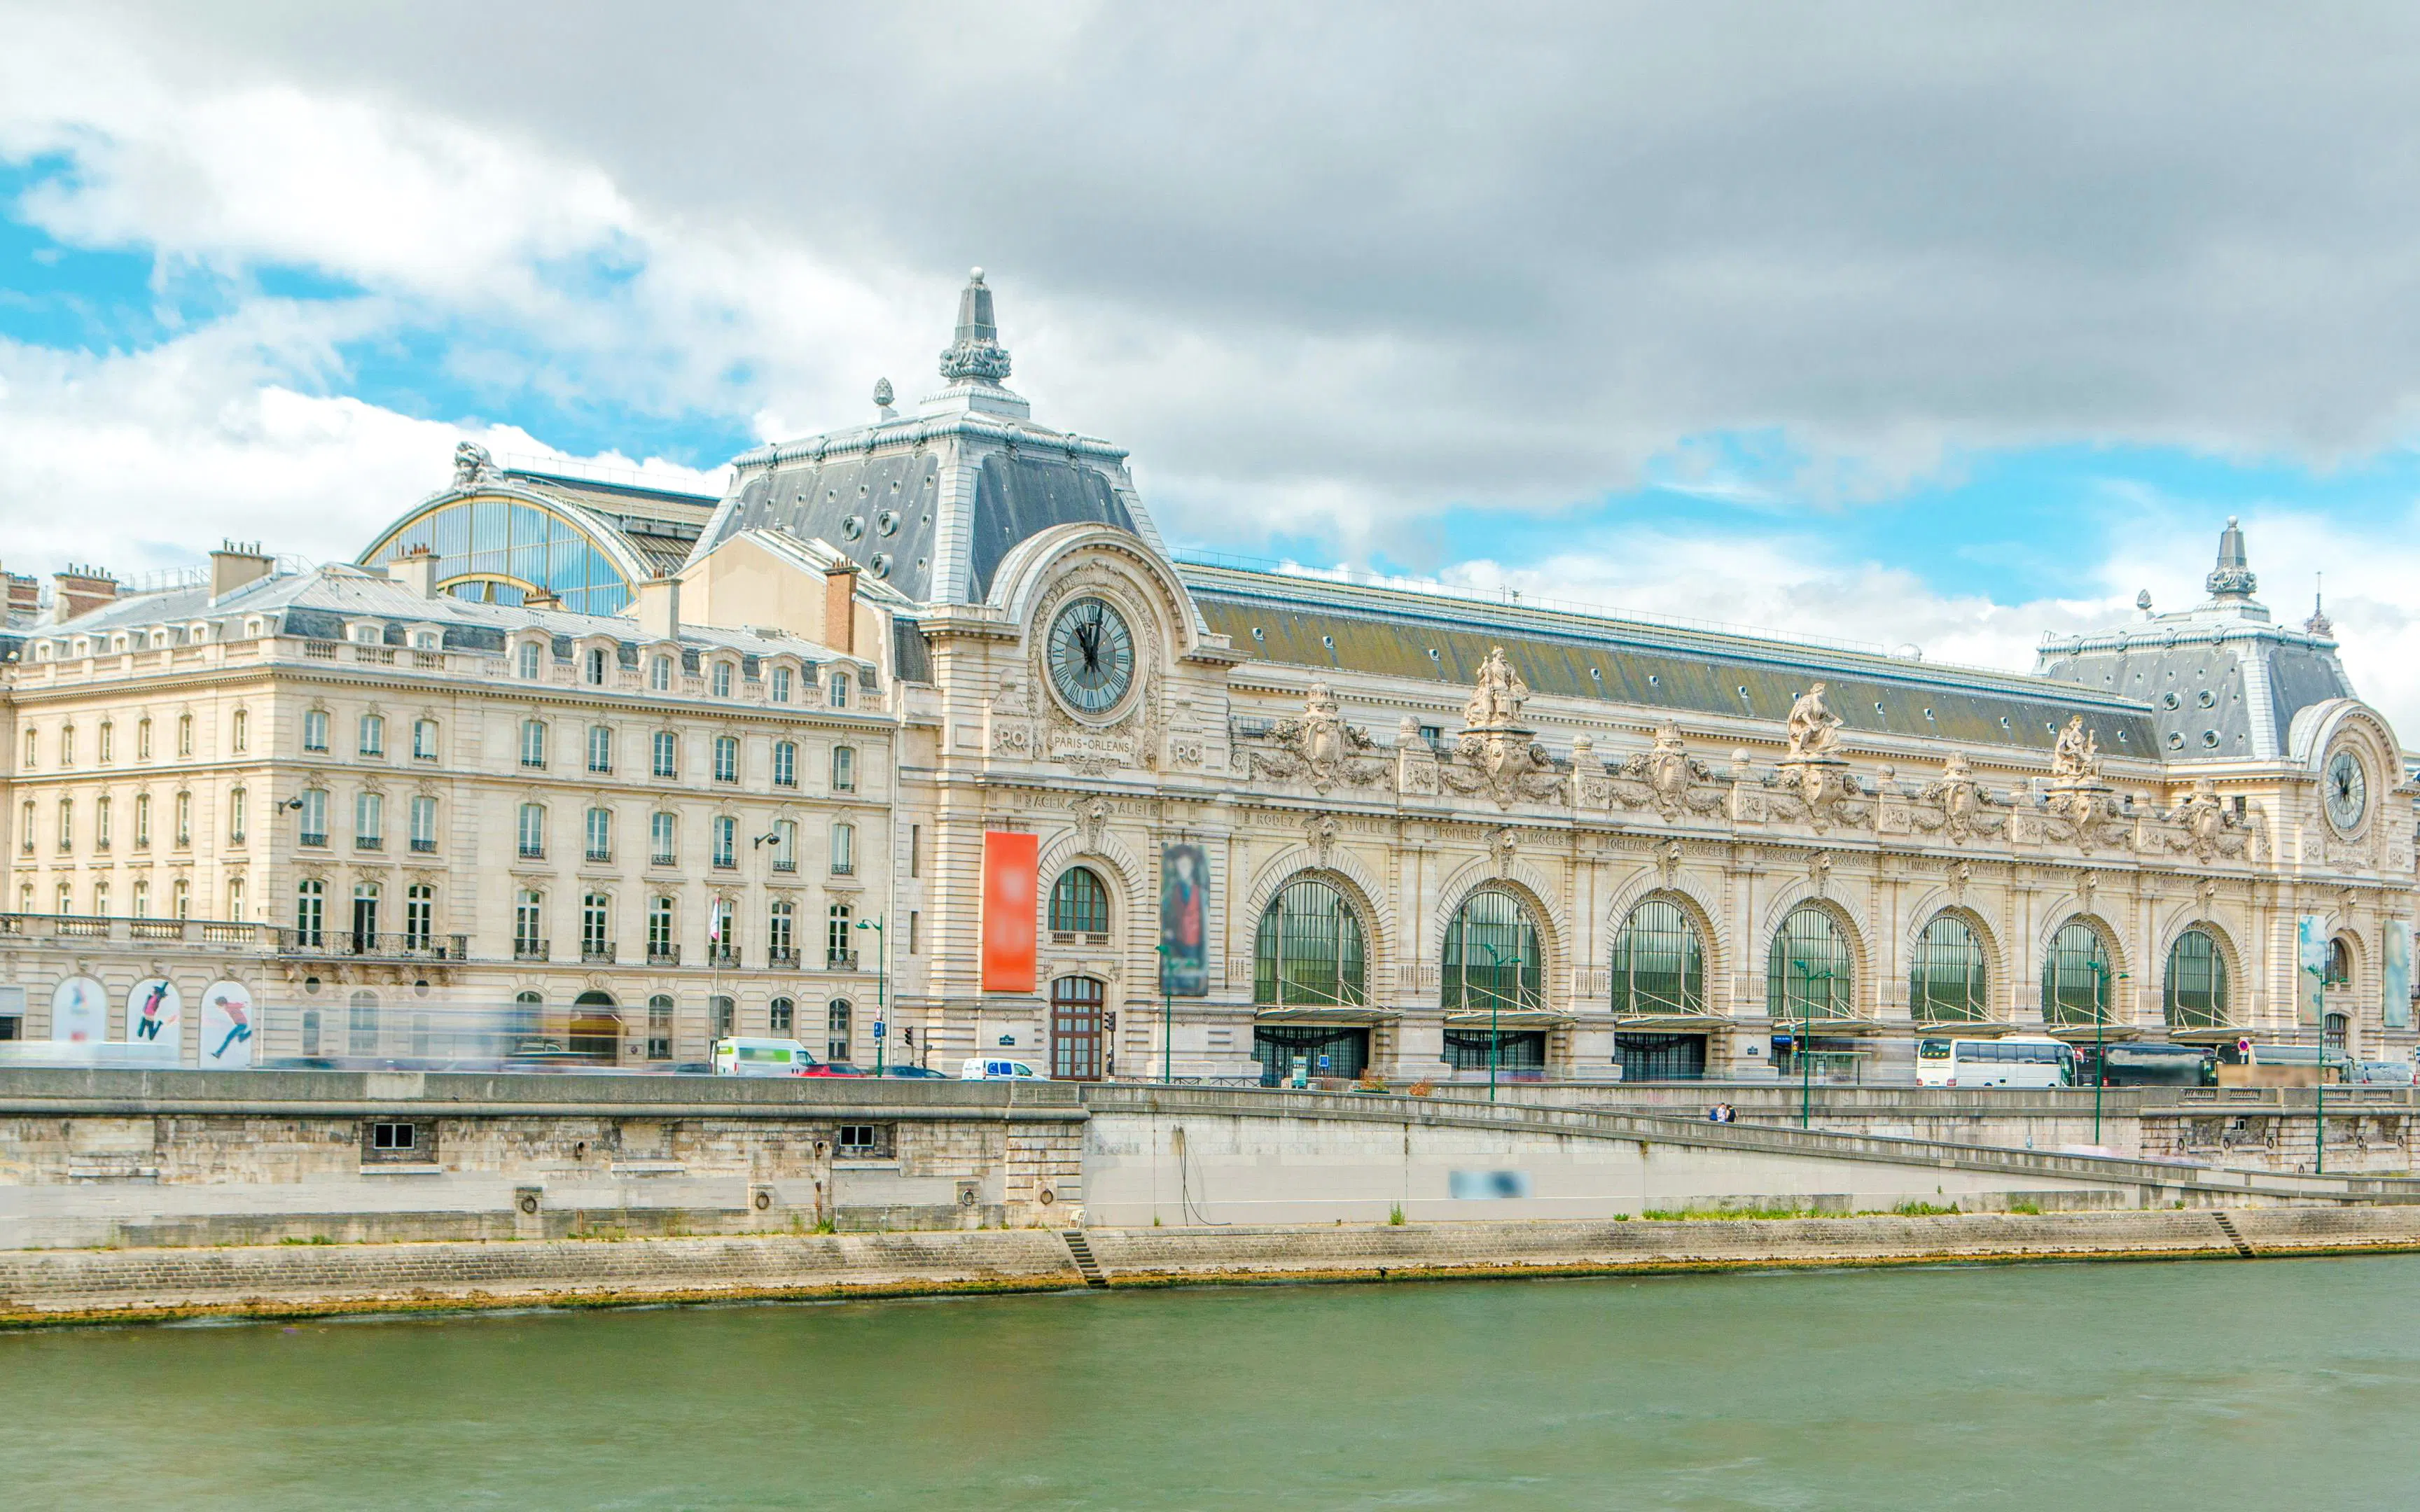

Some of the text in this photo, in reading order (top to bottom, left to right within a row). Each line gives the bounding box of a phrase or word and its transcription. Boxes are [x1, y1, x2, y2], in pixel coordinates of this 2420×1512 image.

[1057, 624, 1071, 638] X
[1113, 632, 1125, 643] II
[1052, 646, 1065, 658] IX
[1116, 654, 1129, 665] III
[1055, 666, 1069, 687] VIII
[1069, 682, 1080, 701] VII
[1086, 690, 1095, 706] VI
[1103, 687, 1111, 703] V
[1000, 729, 1025, 746] PO
[1055, 736, 1130, 753] PARIS-ORLEANS
[1176, 743, 1198, 762] PO
[1410, 769, 1430, 783] PO
[1585, 783, 1603, 797] PO
[1034, 796, 1065, 809] AGEN
[1118, 802, 1146, 815] ALBI
[1745, 797, 1761, 811] PO
[1257, 813, 1295, 827] RODEZ
[1889, 808, 1905, 822] PO
[1347, 820, 1384, 833] TULLE
[1439, 827, 1482, 840] POITIERS
[1522, 833, 1564, 845] LIMOGES
[1611, 839, 1652, 853] ORLEANS
[1687, 845, 1725, 857] BOURGES
[1765, 850, 1805, 862] BORDEAUX
[2307, 844, 2319, 855] PO
[1835, 855, 1872, 867] TOULOUSE
[1911, 861, 1942, 874] NANTES
